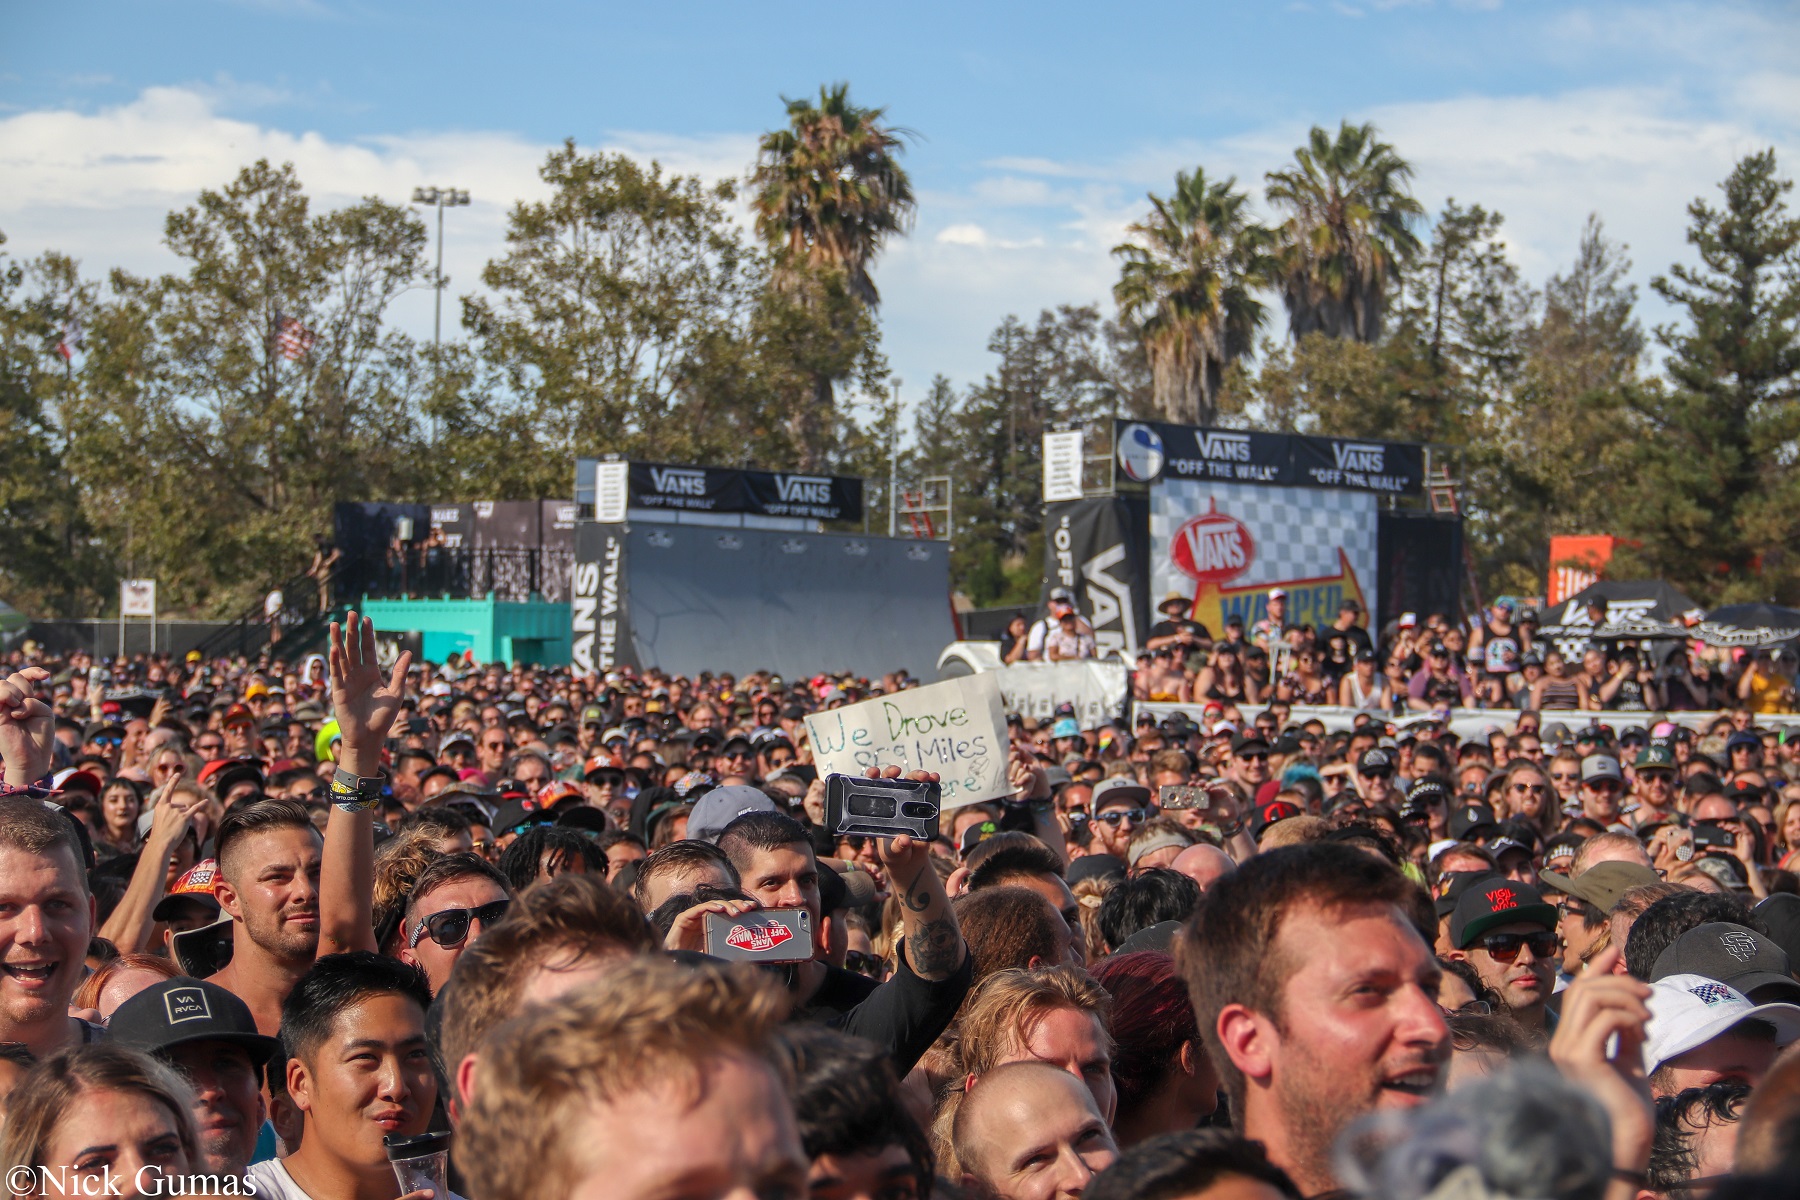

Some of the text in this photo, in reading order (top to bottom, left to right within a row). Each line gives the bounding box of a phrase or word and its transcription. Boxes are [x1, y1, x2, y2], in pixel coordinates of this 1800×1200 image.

[1194, 430, 1251, 462] VANS
[1332, 442, 1385, 473] VANS
[650, 467, 706, 496] VANS
[1168, 458, 1279, 481] "OFF THE WALL"
[1308, 467, 1409, 492] "OFF THE WALL"
[774, 474, 832, 503] VANS
[666, 496, 684, 508] THE
[790, 505, 809, 516] THE
[1184, 522, 1246, 572] VANS
[601, 536, 621, 616] WALL"
[599, 618, 617, 670] THE
[809, 712, 873, 755] We
[883, 701, 969, 741] Drove
[916, 736, 987, 768] Miles
[940, 776, 982, 799] ere
[1485, 888, 1517, 903] VIGIL
[1497, 897, 1511, 905] OF
[731, 927, 788, 945] "OFF THE WALL"
[751, 938, 774, 950] VANS
[175, 1005, 203, 1014] RVCA
[176, 996, 195, 1004] VA
